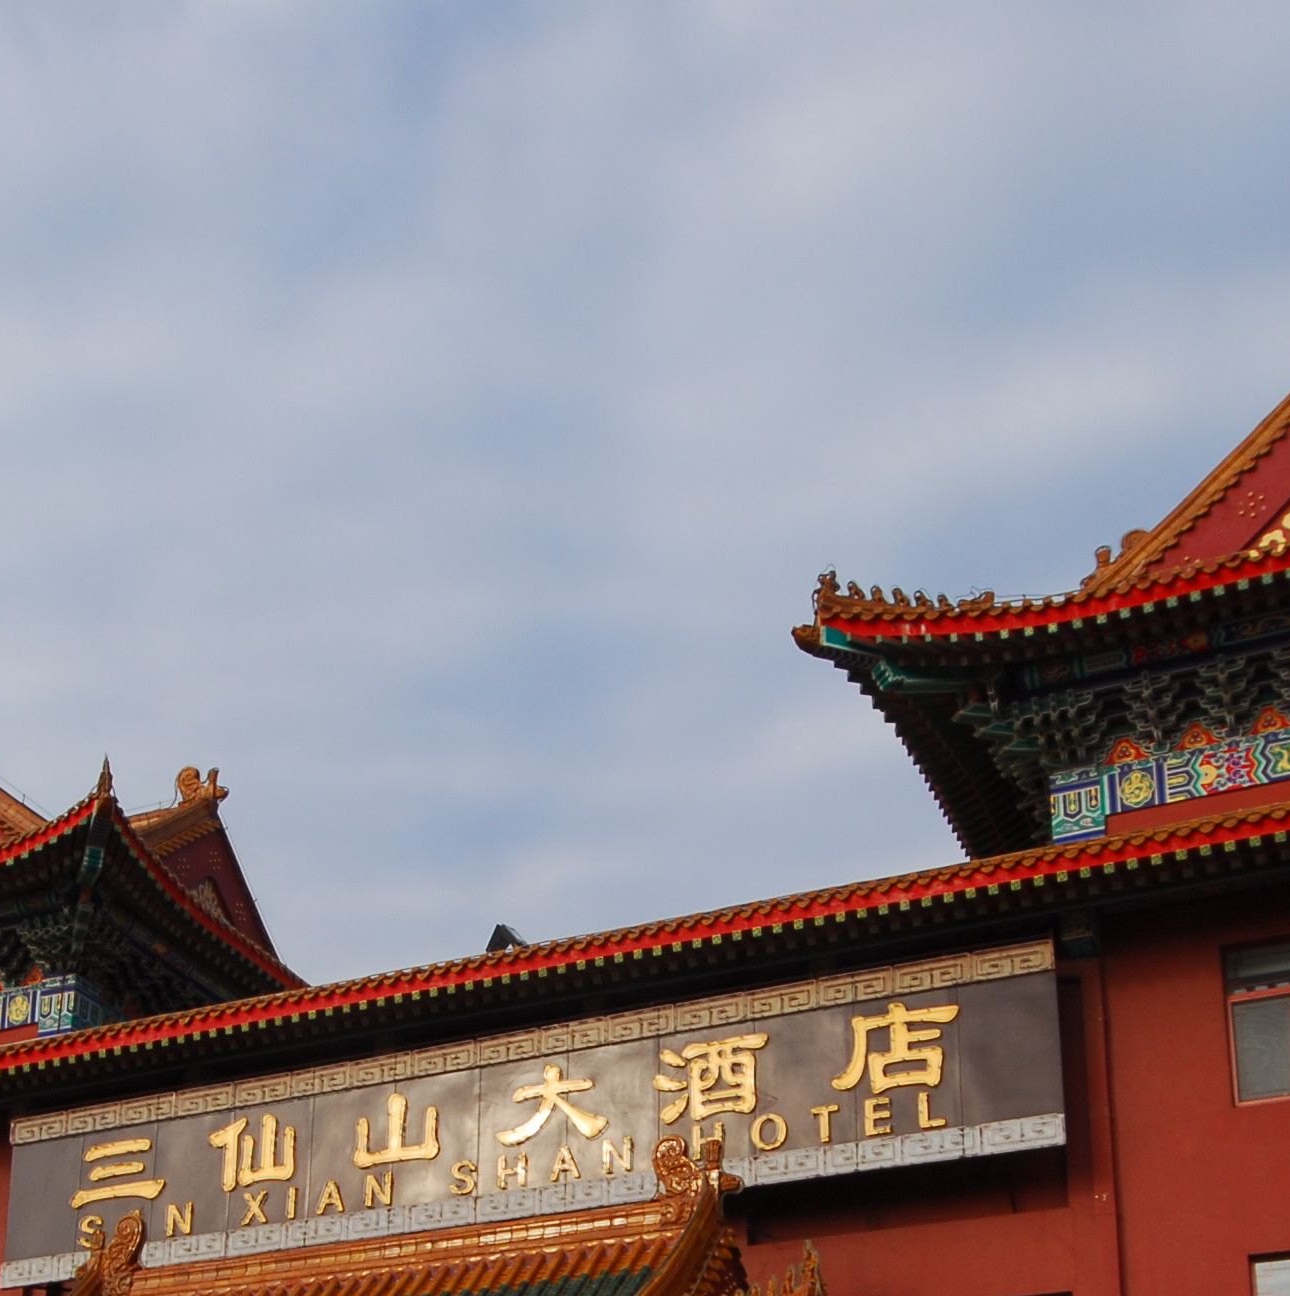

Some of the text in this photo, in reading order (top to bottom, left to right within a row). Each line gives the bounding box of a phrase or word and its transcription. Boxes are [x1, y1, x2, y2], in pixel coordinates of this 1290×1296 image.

[70, 1001, 960, 1210] 三仙山大酒店
[76, 1090, 947, 1249] SN XIAN SHAN HOTEL
